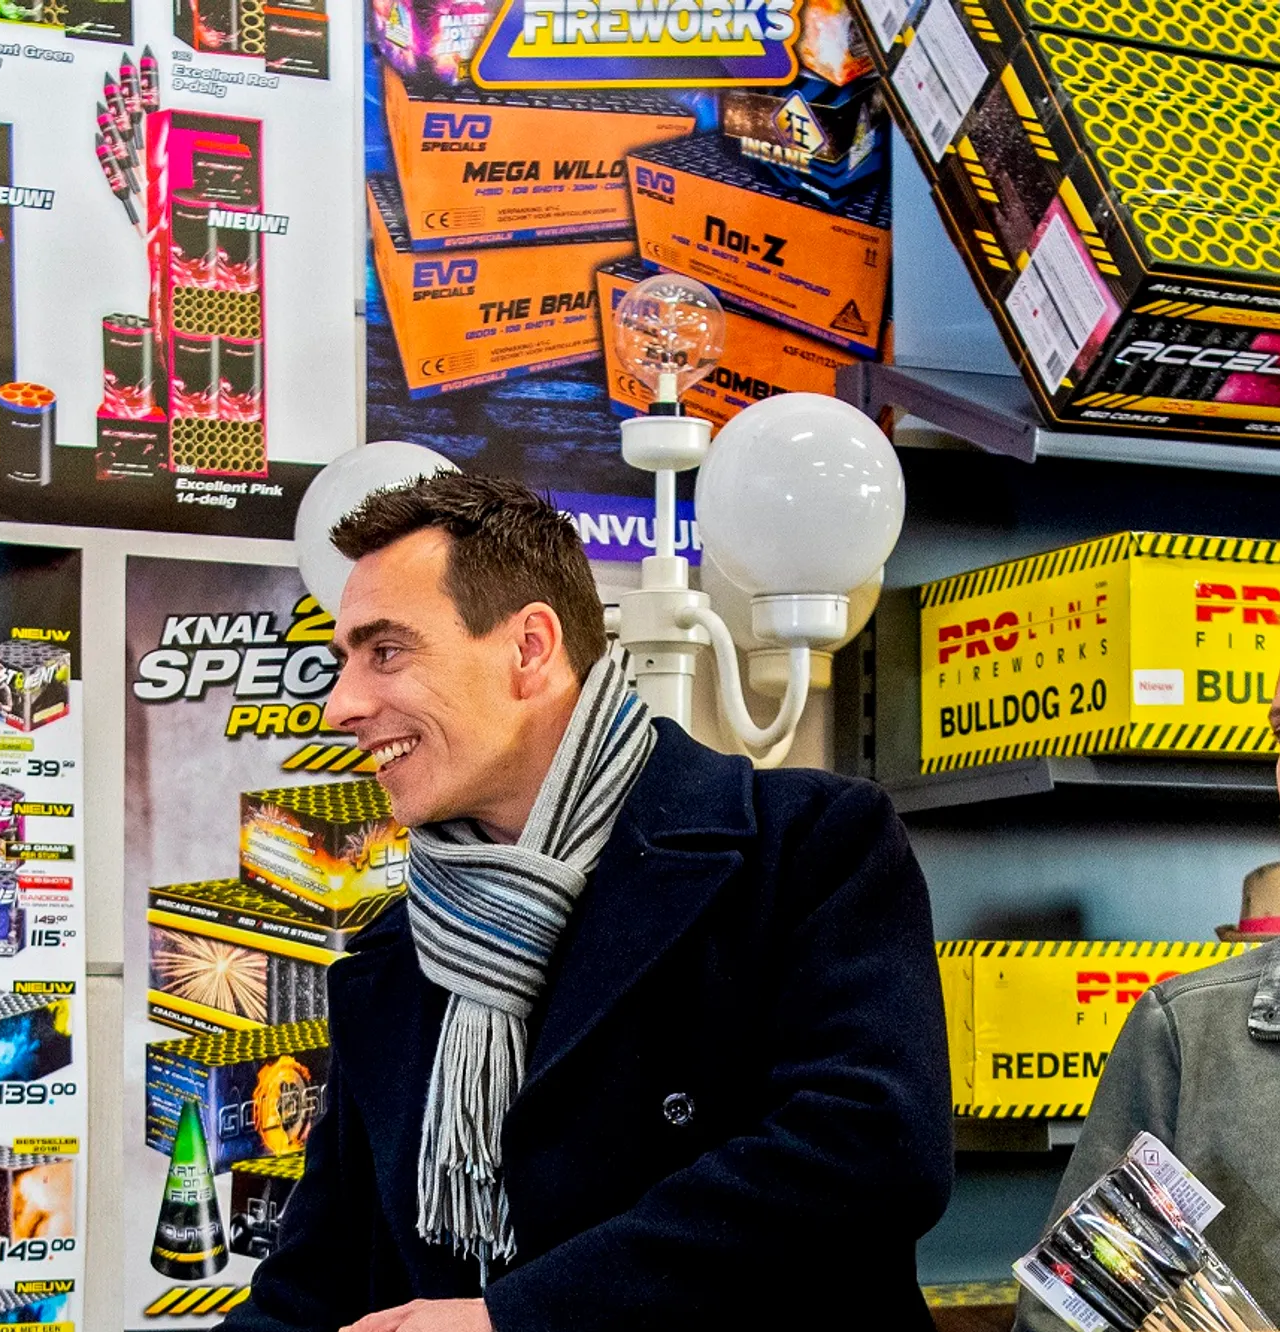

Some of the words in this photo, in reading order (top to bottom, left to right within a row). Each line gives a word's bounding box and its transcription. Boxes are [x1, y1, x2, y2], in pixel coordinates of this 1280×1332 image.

[521, 0, 795, 43] FIREWORKS
[24, 46, 74, 62] Green
[172, 63, 242, 85] Excellent
[247, 74, 280, 87] Red
[423, 112, 492, 139] EVO
[421, 141, 487, 153] SPECIALS
[741, 136, 814, 175] INSANE
[462, 160, 541, 184] MEGA
[207, 210, 289, 235] NIEUW!
[413, 258, 479, 288] EVO
[413, 286, 476, 302] SPECIALS
[479, 297, 532, 324] THE
[175, 478, 246, 495] Excellent
[249, 482, 284, 499] Pink
[11, 627, 70, 642] NIEUW
[162, 612, 279, 646] KNAL
[938, 637, 1108, 687] FIREWORKS
[939, 684, 1061, 740] BULLDOG
[1069, 678, 1108, 715] 2.0
[14, 803, 72, 818] NIEUW
[14, 981, 75, 994] NIEUW
[16, 1281, 73, 1293] NIEUW
